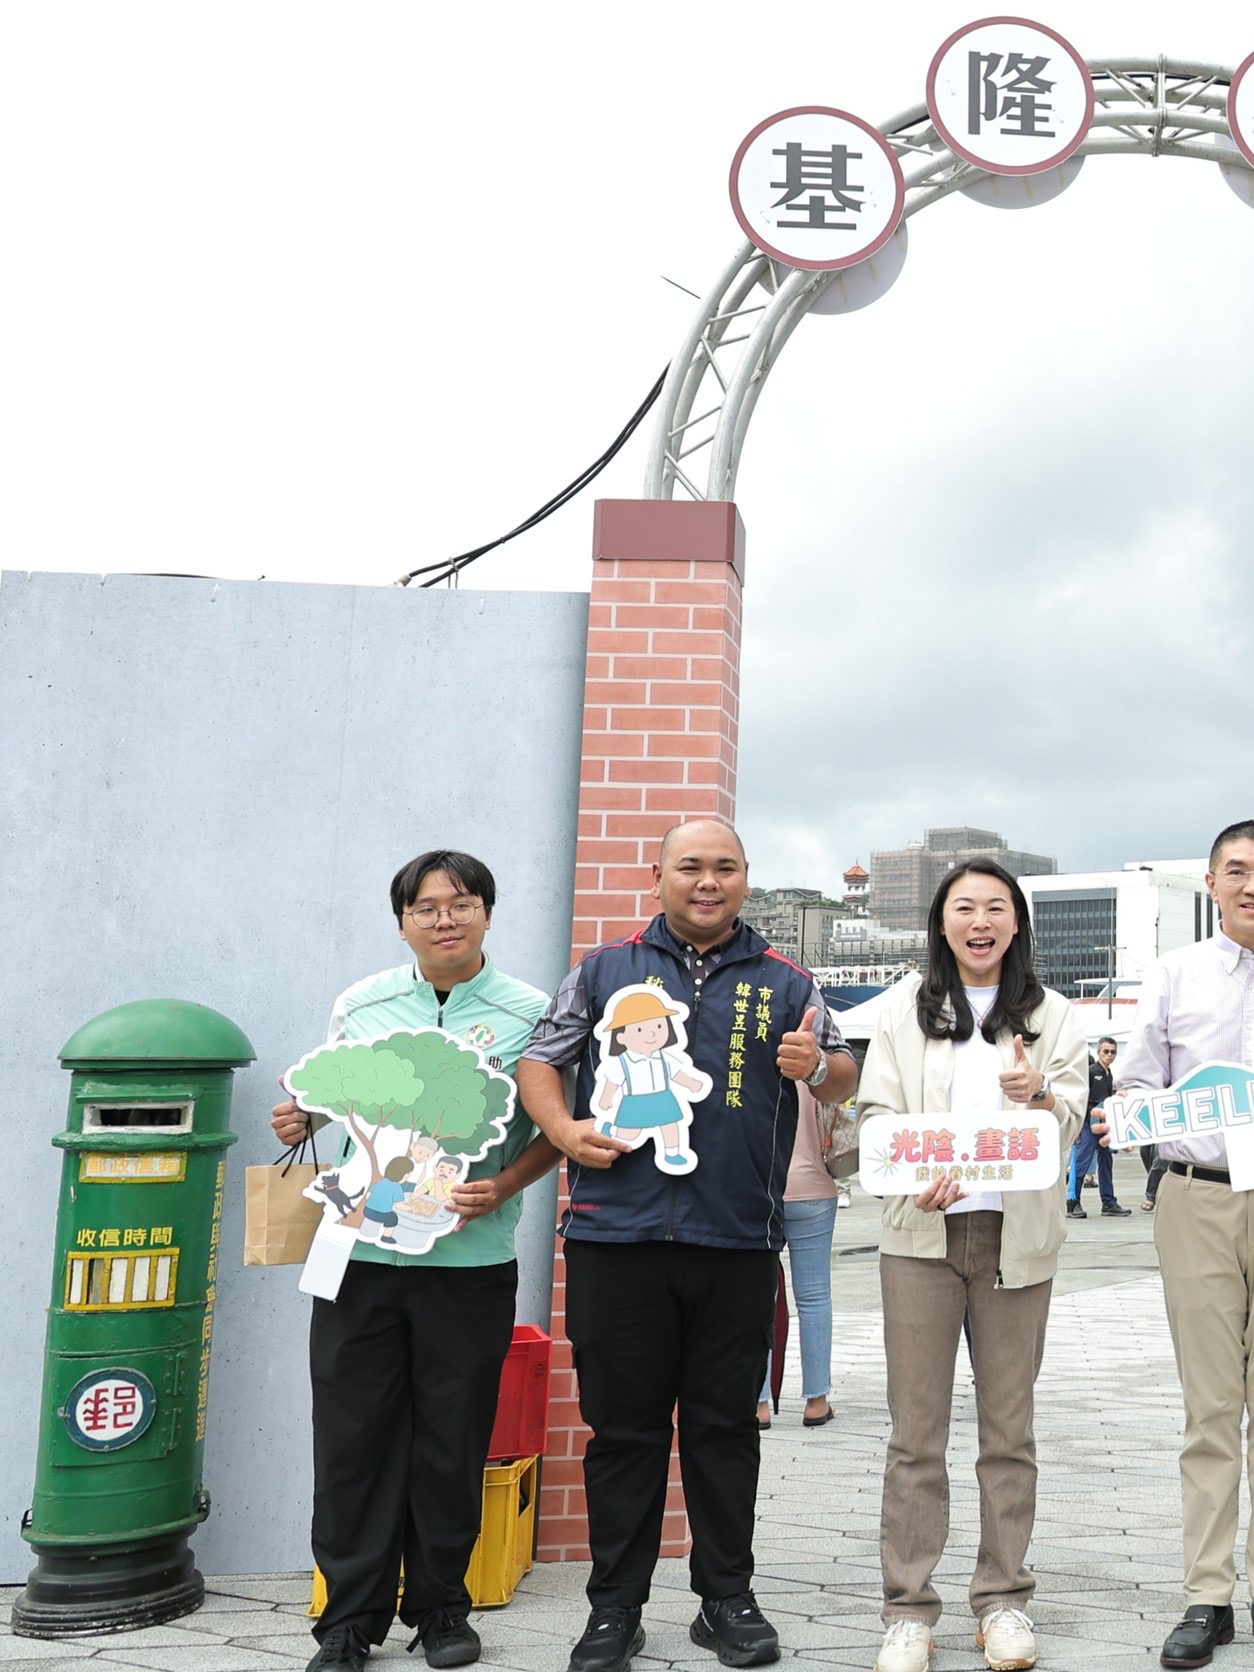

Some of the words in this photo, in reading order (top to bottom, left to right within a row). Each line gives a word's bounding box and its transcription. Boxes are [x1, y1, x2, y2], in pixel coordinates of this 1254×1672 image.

[754, 986, 774, 1042] 市議員
[725, 981, 752, 1108] 韓世昱服務團隊
[76, 1226, 174, 1247] 收信時間
